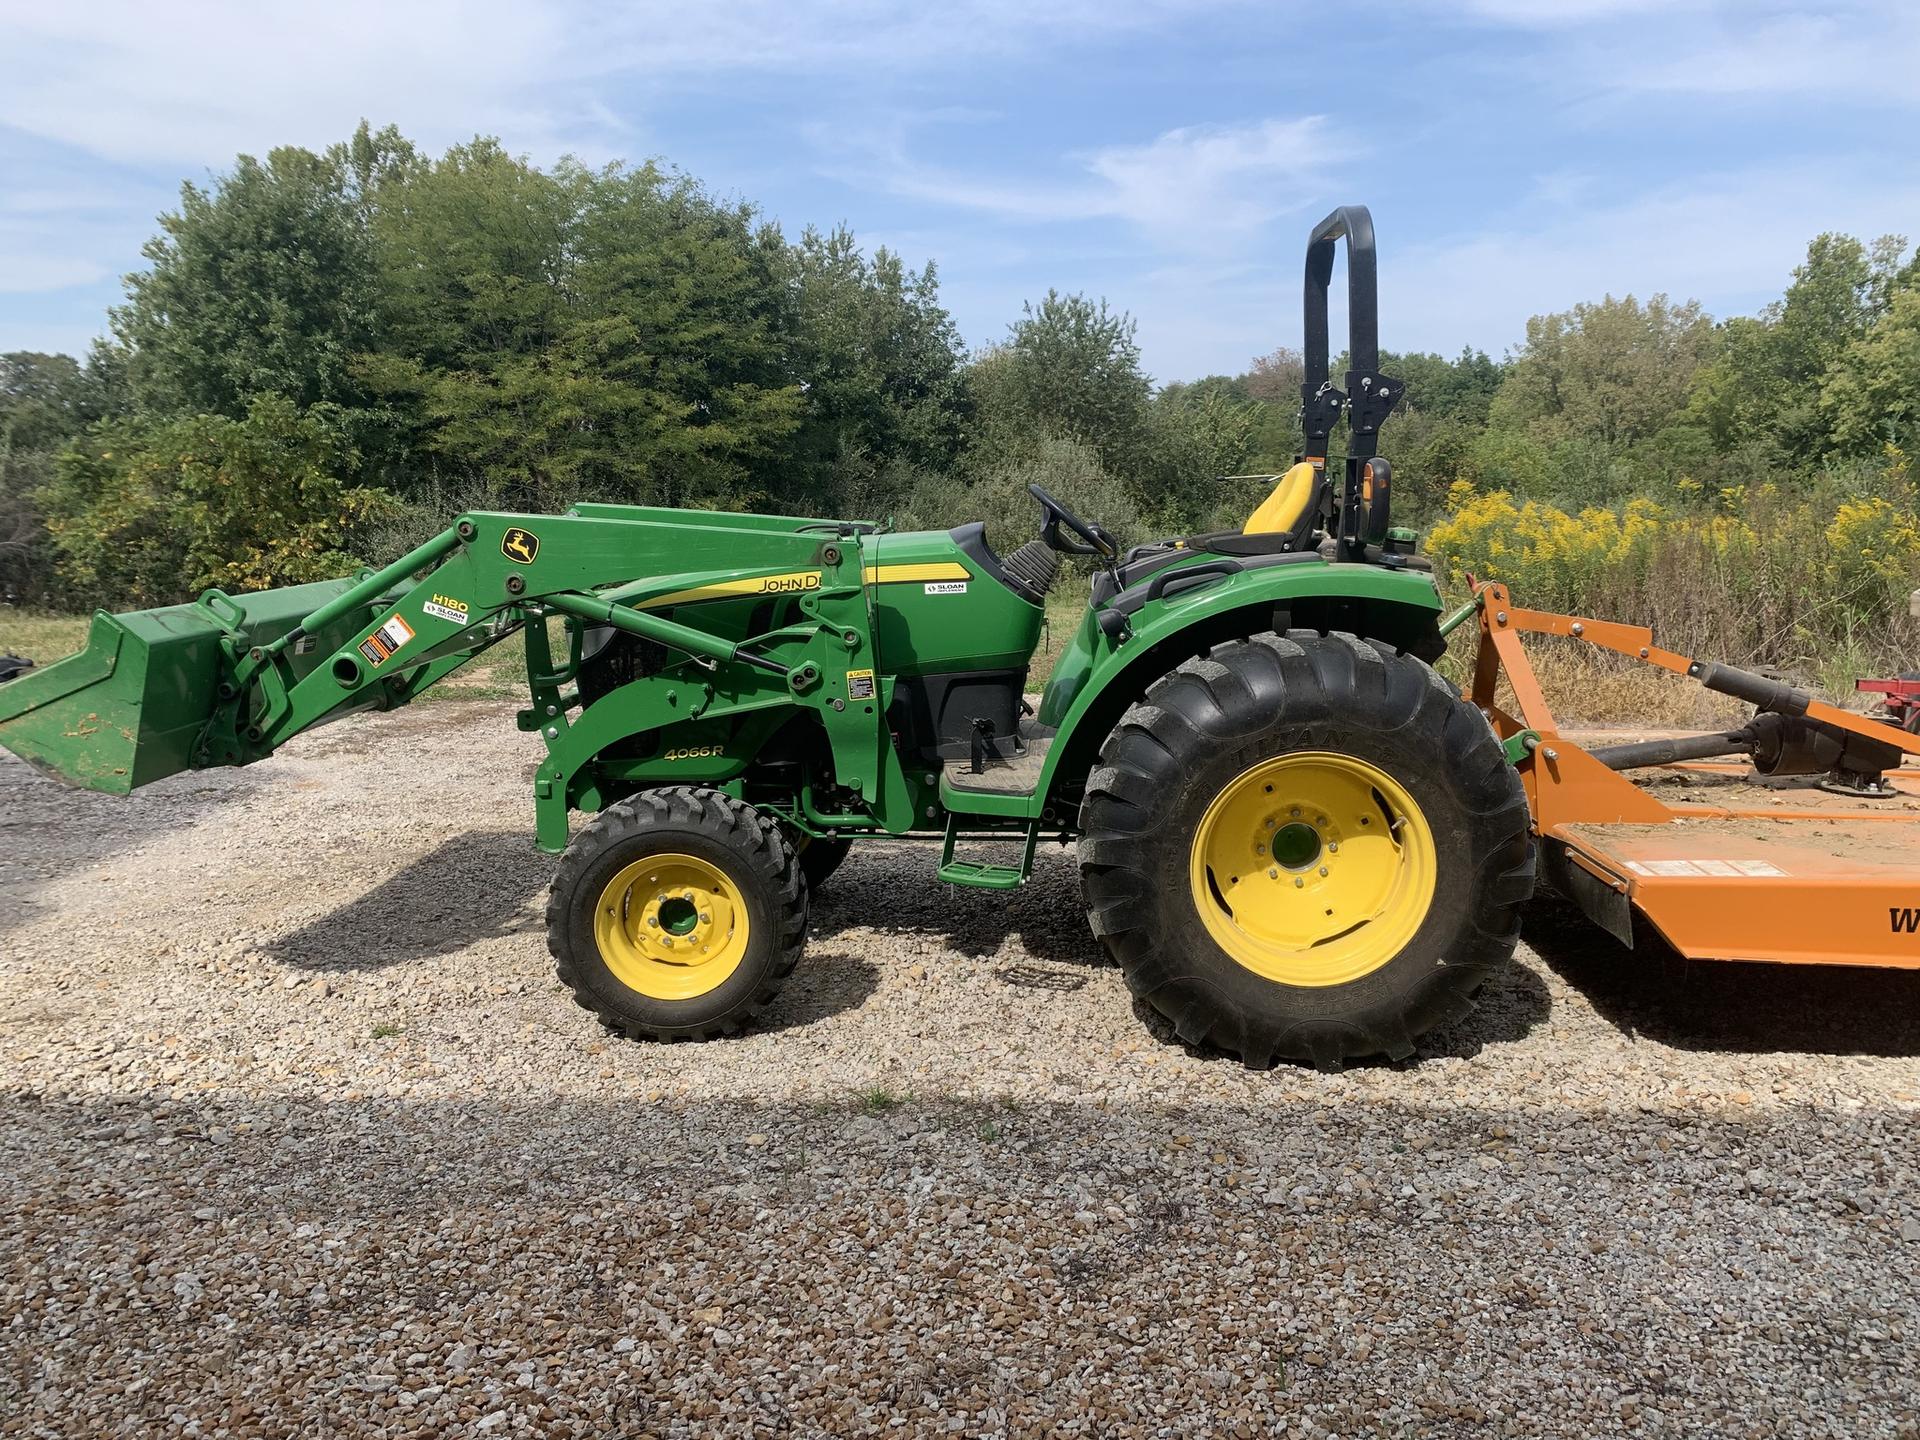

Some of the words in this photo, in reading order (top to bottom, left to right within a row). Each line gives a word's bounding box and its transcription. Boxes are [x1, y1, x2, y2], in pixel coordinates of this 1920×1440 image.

[758, 579, 802, 592] JOHN
[806, 575, 821, 588] D
[937, 582, 964, 590] SLOAN
[432, 593, 468, 612] H180
[437, 607, 465, 620] SLOAN
[664, 746, 724, 760] 4066R
